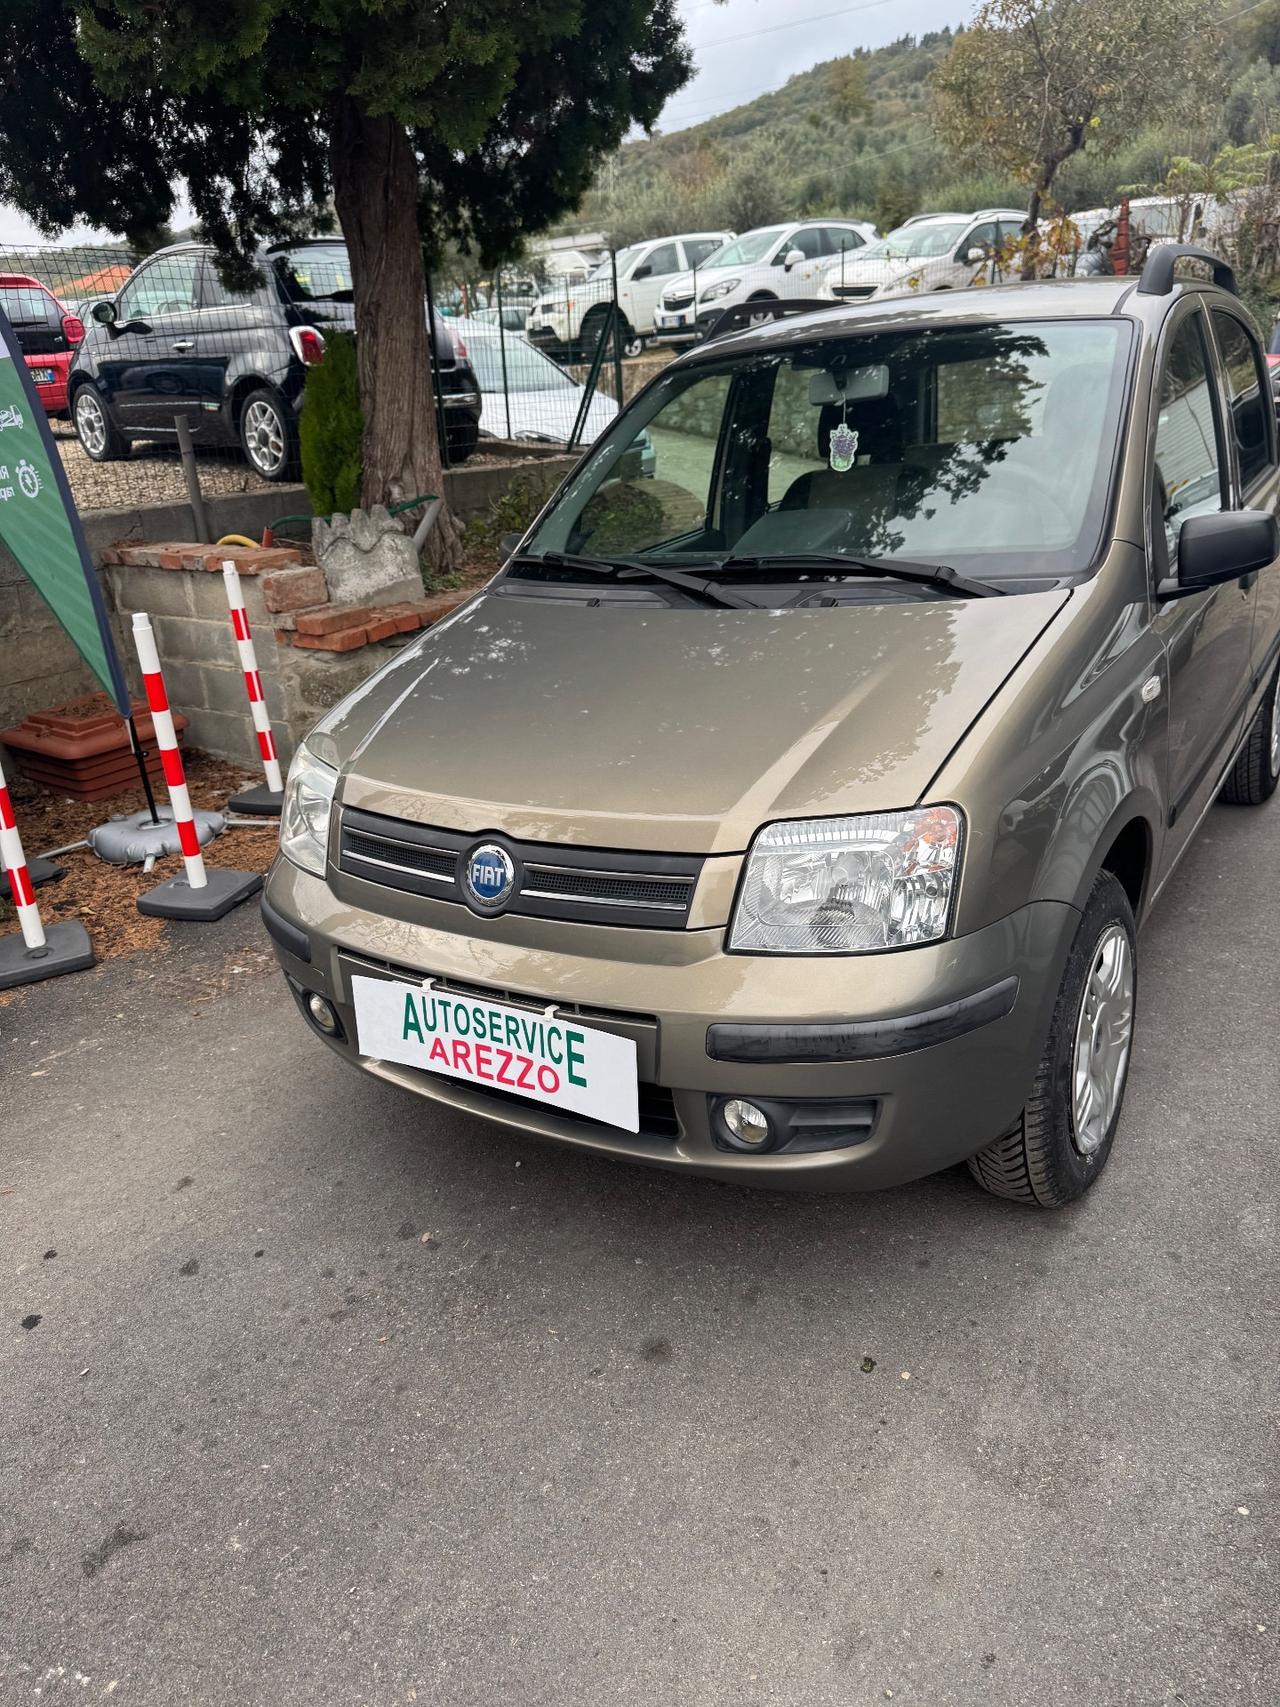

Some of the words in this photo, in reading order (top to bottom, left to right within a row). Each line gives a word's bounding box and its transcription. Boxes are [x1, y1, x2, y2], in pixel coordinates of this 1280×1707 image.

[472, 863, 505, 887] FIAT
[402, 992, 588, 1088] AUTOSERVICE
[429, 1037, 560, 1094] AREZZO
